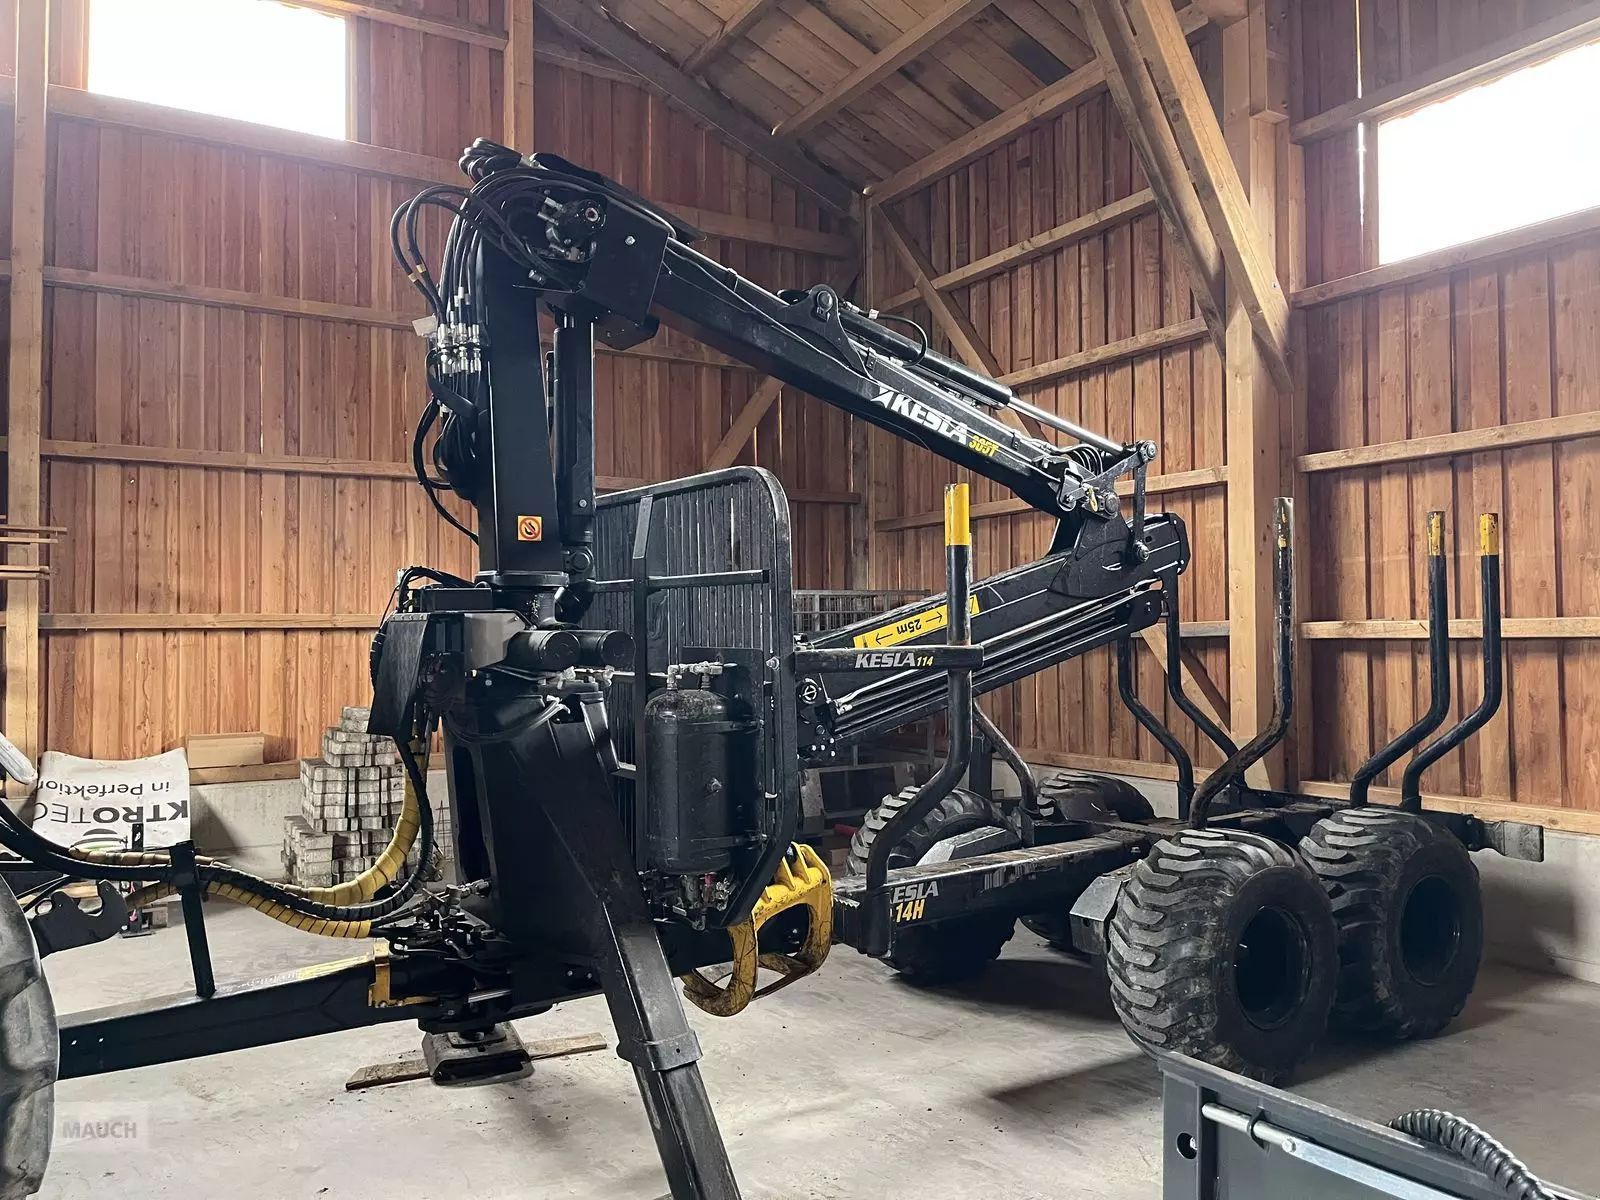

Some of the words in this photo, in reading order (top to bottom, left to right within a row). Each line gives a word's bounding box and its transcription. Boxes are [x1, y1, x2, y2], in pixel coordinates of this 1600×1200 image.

[890, 393, 968, 445] KESLA
[897, 618, 922, 634] 25m
[854, 652, 915, 669] KESLA
[916, 656, 934, 667] 114
[151, 781, 170, 793] in
[890, 881, 939, 904] ESLA
